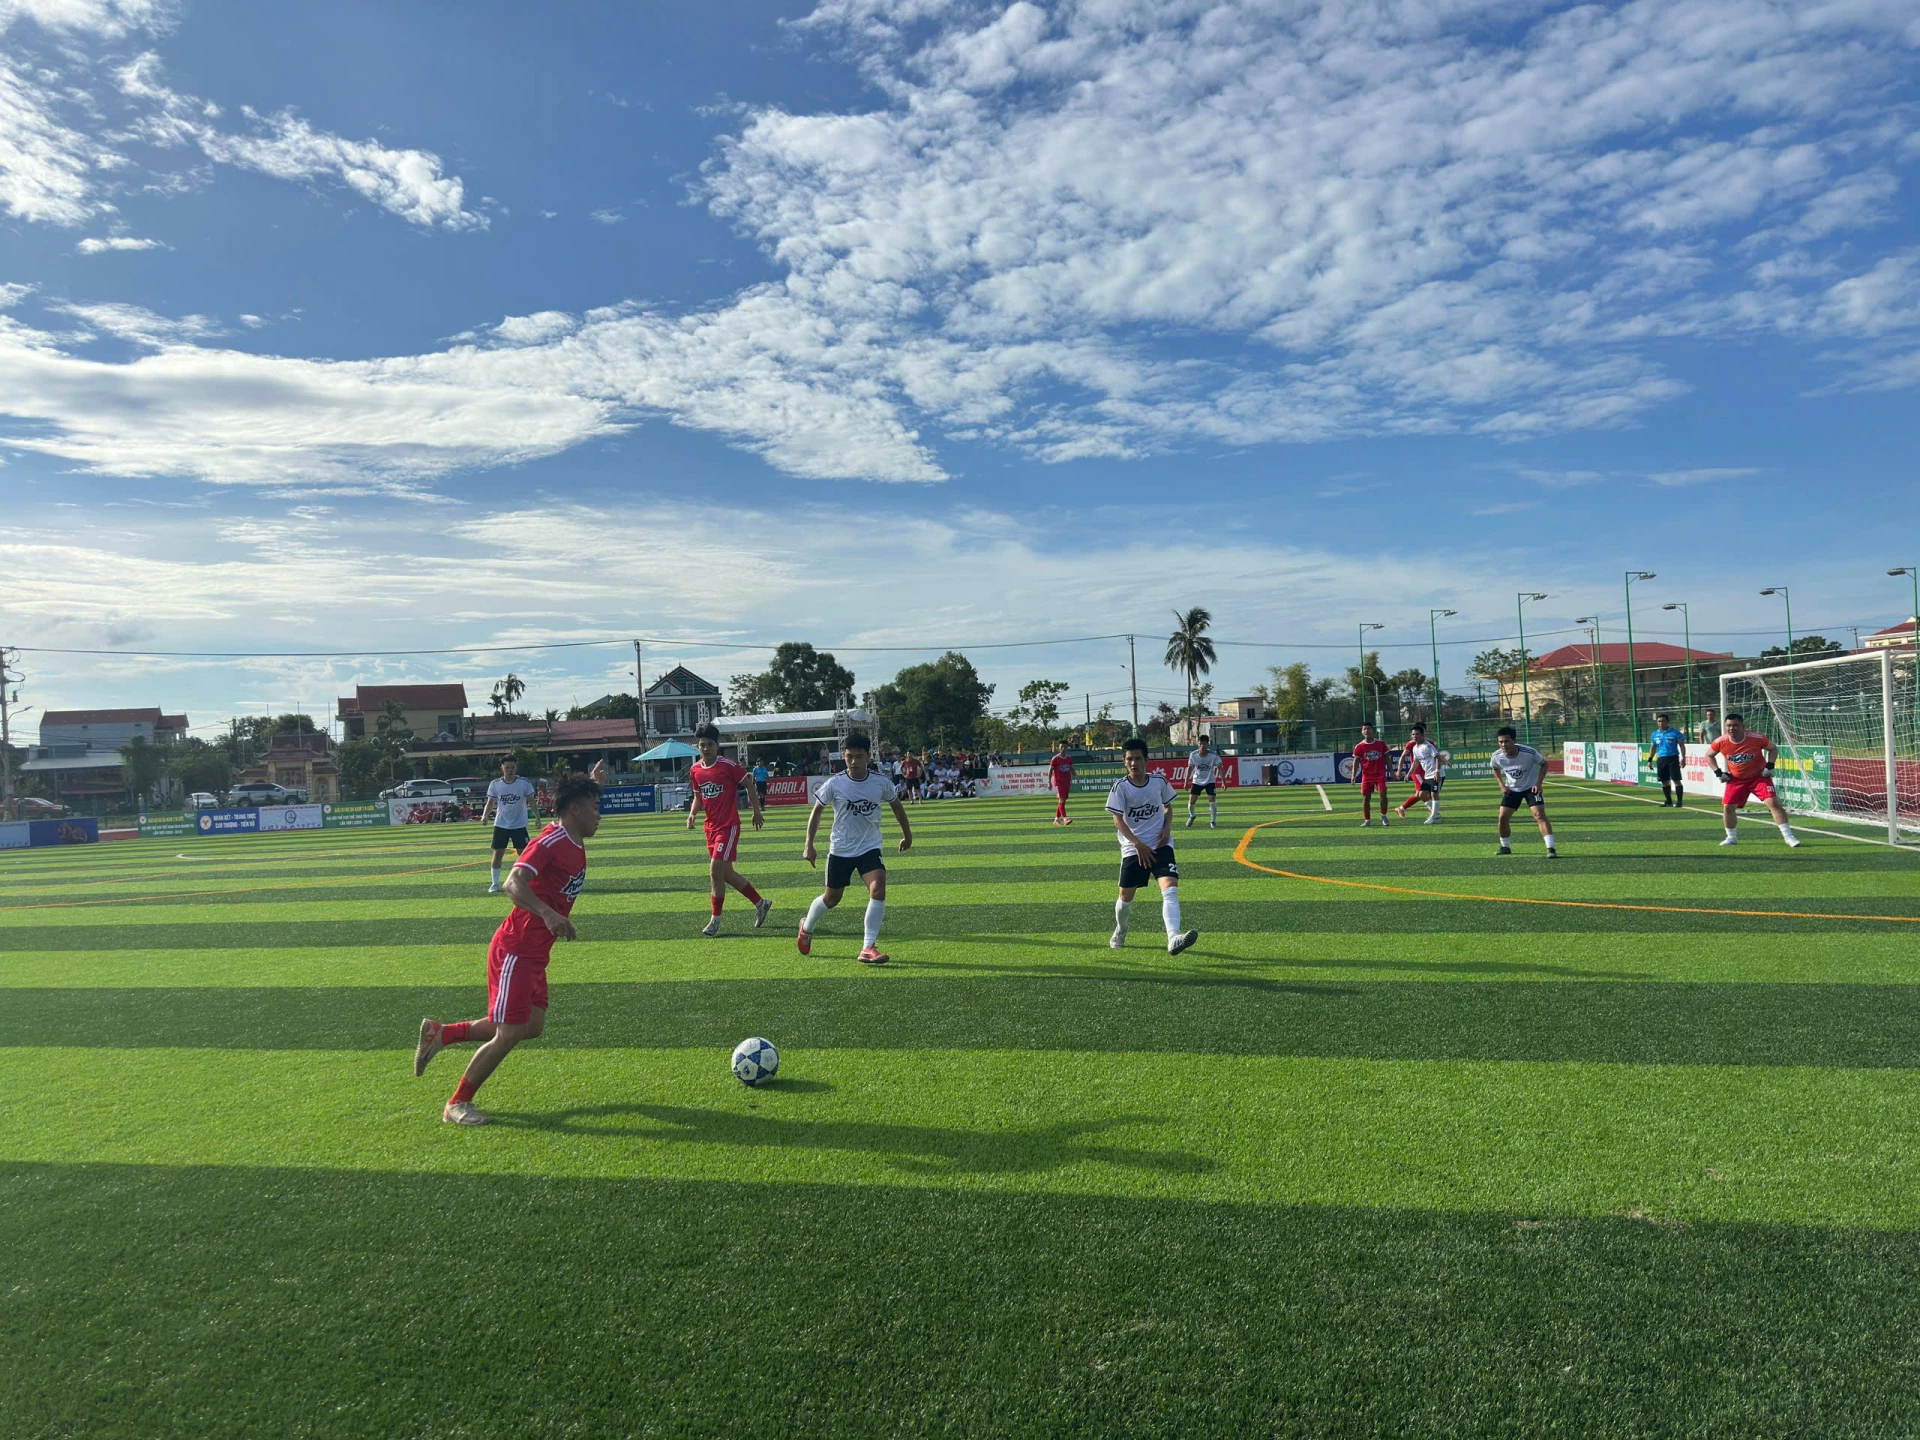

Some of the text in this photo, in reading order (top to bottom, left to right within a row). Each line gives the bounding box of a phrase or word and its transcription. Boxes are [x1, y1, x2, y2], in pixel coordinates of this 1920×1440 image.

[846, 799, 878, 816] huda
[1128, 803, 1159, 822] huda
[717, 842, 724, 852] 6
